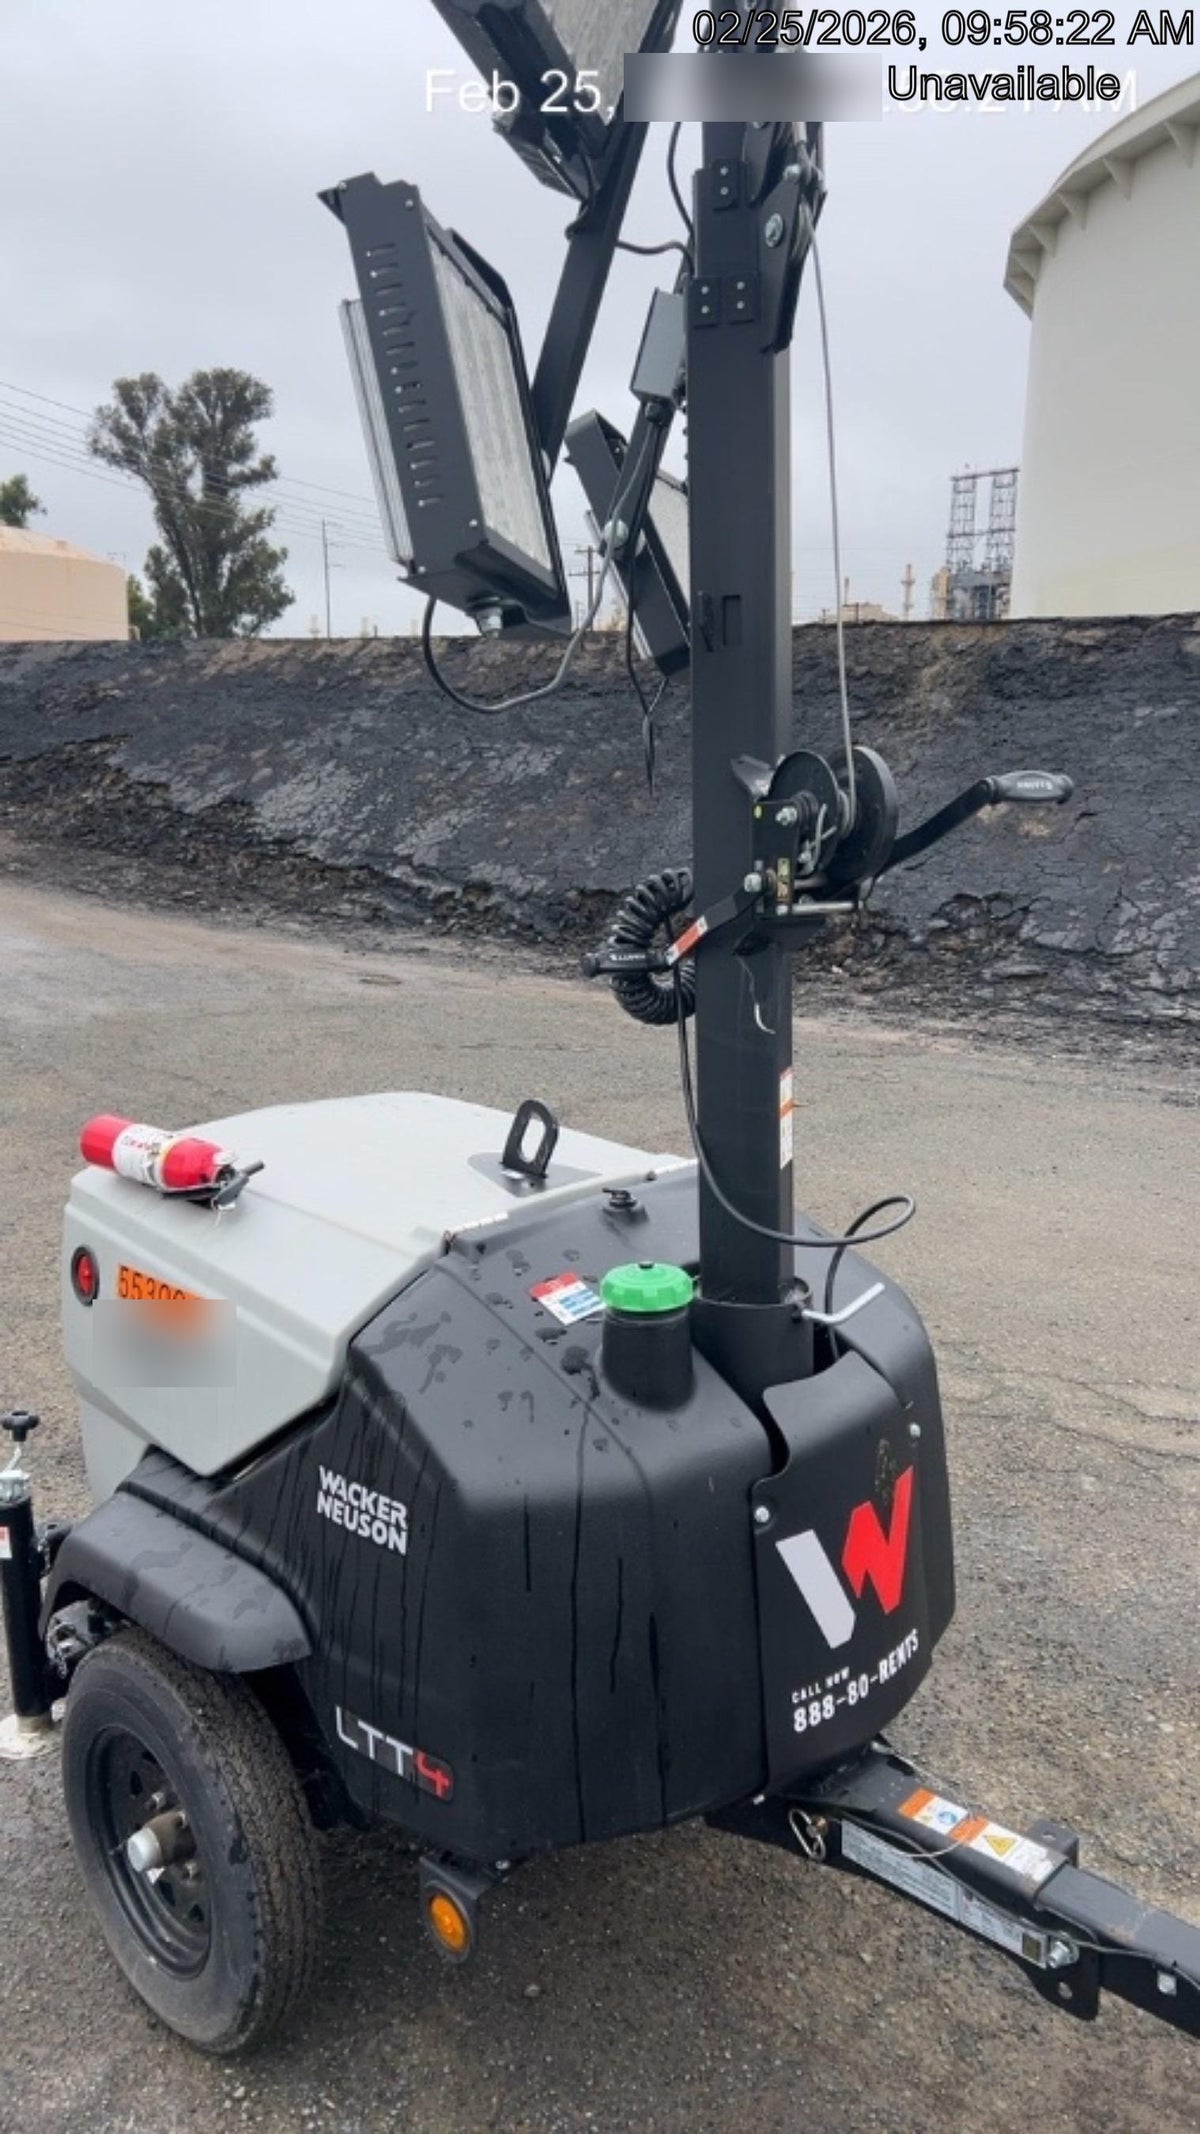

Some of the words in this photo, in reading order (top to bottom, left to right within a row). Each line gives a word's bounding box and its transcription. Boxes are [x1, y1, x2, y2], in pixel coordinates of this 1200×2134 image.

[317, 1491, 407, 1555] NEUSON
[319, 1465, 408, 1529] WACKER
[791, 1682, 822, 1704] CALL
[793, 1628, 919, 1733] 888-80-RENTS
[335, 1706, 451, 1798] LTT4
